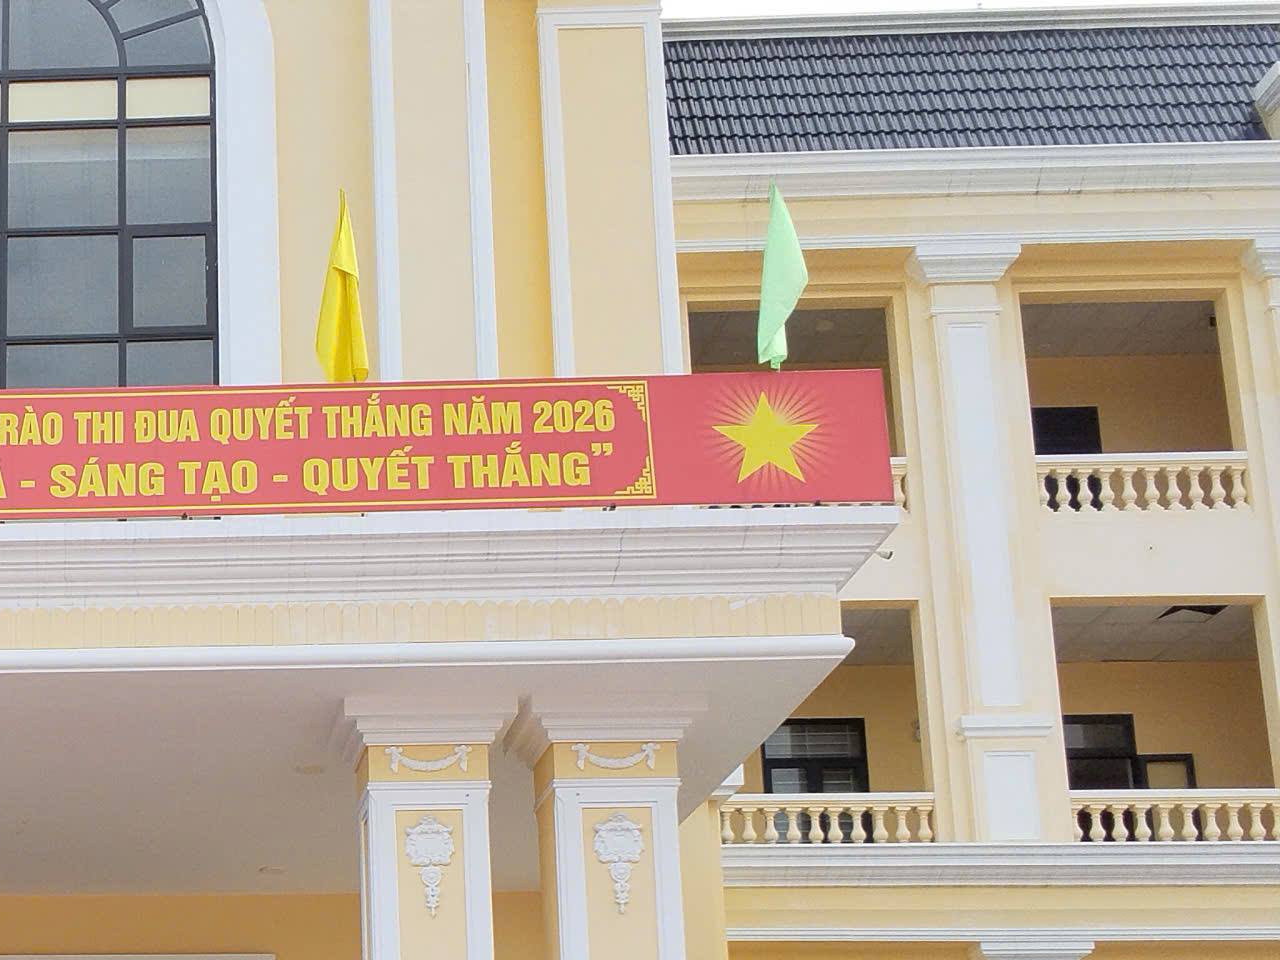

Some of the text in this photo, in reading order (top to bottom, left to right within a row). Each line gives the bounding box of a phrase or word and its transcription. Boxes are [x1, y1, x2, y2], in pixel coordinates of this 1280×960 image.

[73, 410, 124, 443] THI
[134, 408, 199, 442] ĐUA
[209, 396, 312, 444] QUYẾT
[322, 393, 432, 438] THẮNG
[442, 396, 522, 435] NĂM
[532, 399, 615, 433] 2026
[20, 479, 34, 487] -
[49, 456, 164, 497] SÁNG
[178, 459, 257, 501] TẠO
[302, 446, 433, 496] QUYẾT
[447, 440, 613, 490] THẮNG”
